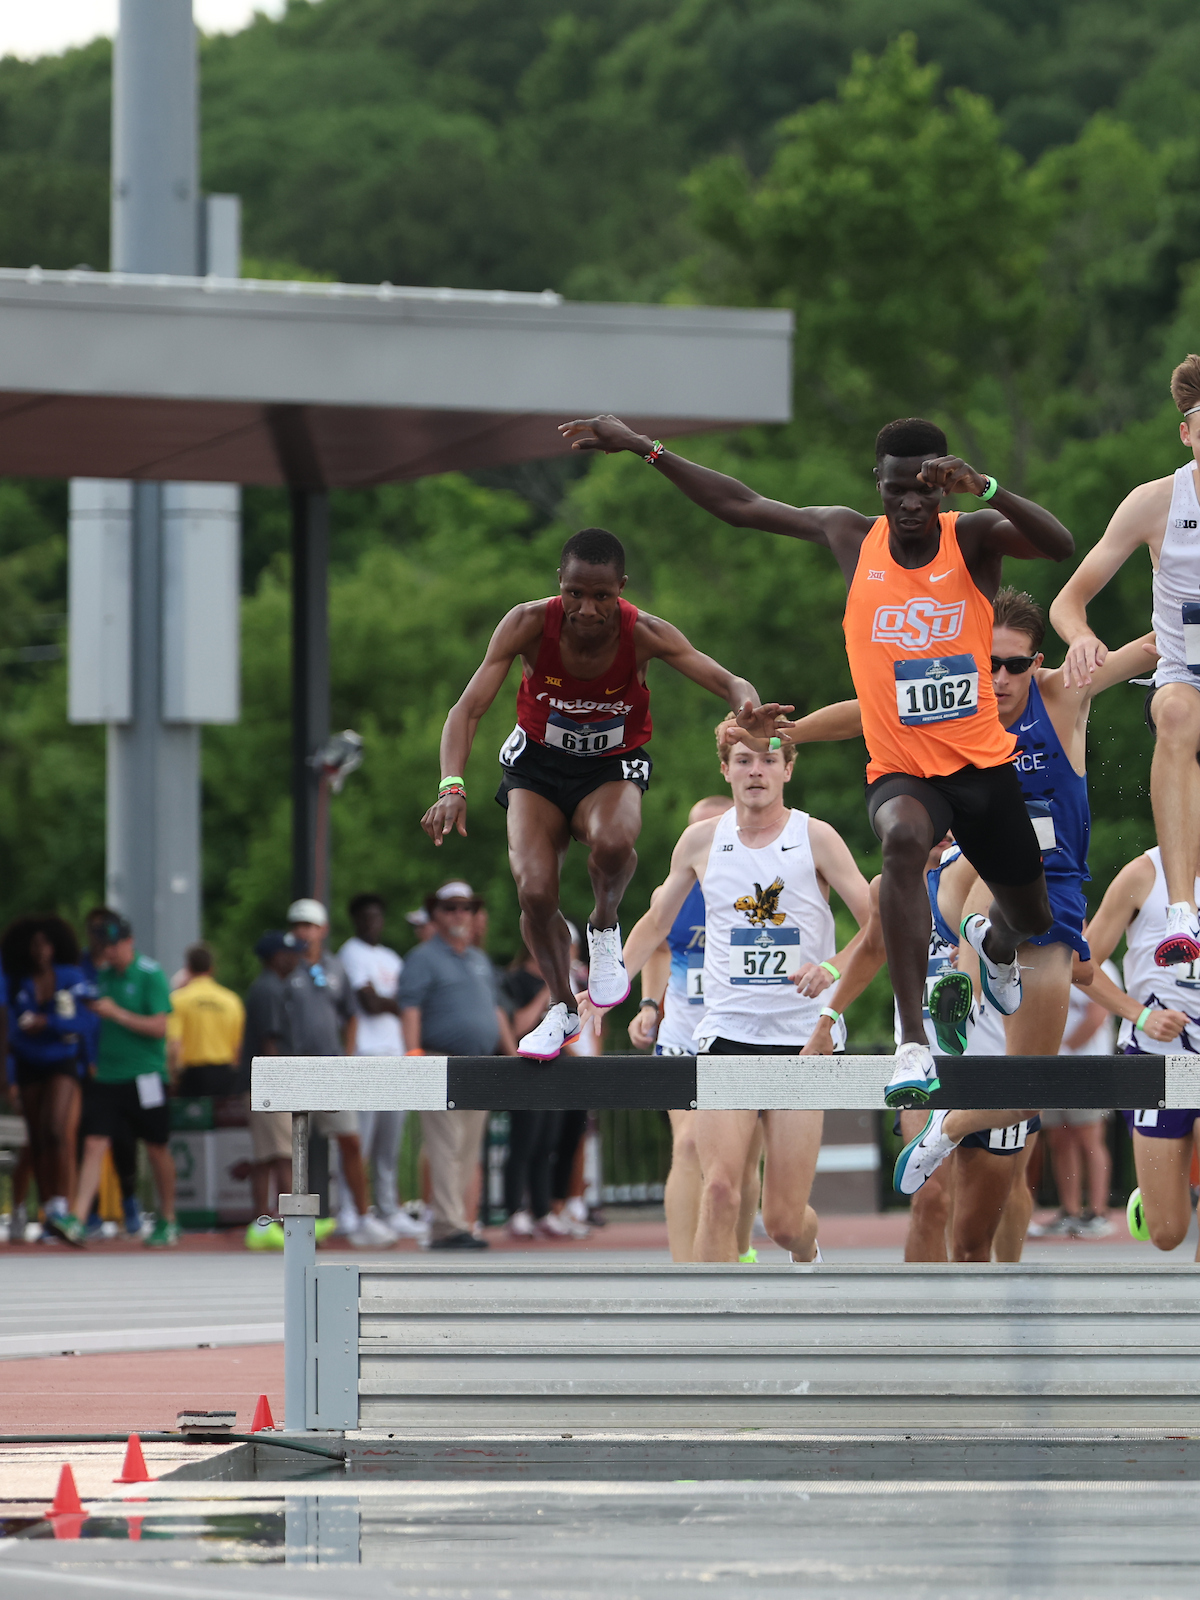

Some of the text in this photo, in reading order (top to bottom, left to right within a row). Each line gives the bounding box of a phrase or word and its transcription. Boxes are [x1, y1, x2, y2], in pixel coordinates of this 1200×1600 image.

[1175, 519, 1197, 529] BIG
[872, 598, 965, 651] OSU
[545, 676, 562, 687] XII
[906, 679, 972, 713] 1062
[562, 733, 609, 752] 610
[1012, 753, 1045, 771] RCE
[744, 951, 787, 975] 572
